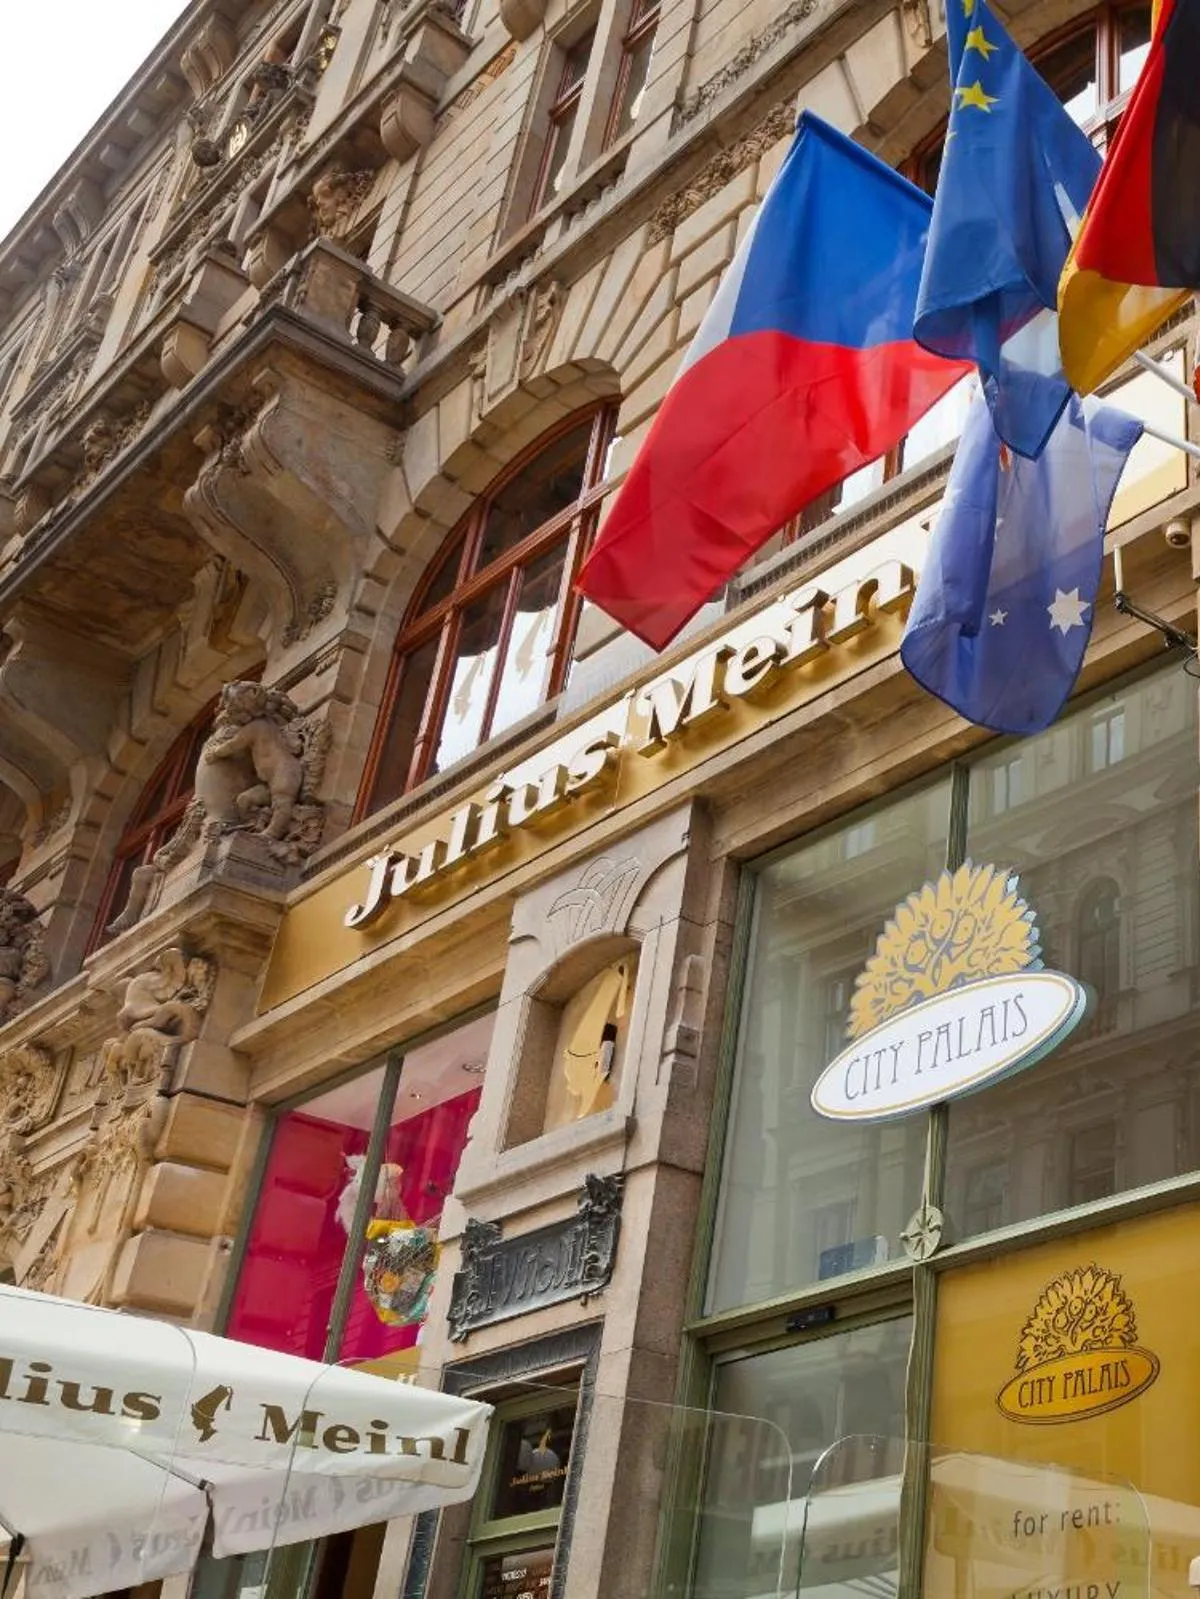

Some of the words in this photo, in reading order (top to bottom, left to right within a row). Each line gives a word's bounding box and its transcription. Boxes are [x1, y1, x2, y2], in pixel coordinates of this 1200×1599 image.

[344, 730, 621, 931] Julius
[844, 1040, 903, 1101] CITY
[914, 992, 1028, 1075] PALAIS
[1018, 1375, 1056, 1409] CITY
[1062, 1358, 1131, 1400] PALAIS
[253, 1401, 470, 1467] Meinl
[1013, 1509, 1048, 1538] for
[1060, 1501, 1121, 1531] rent:
